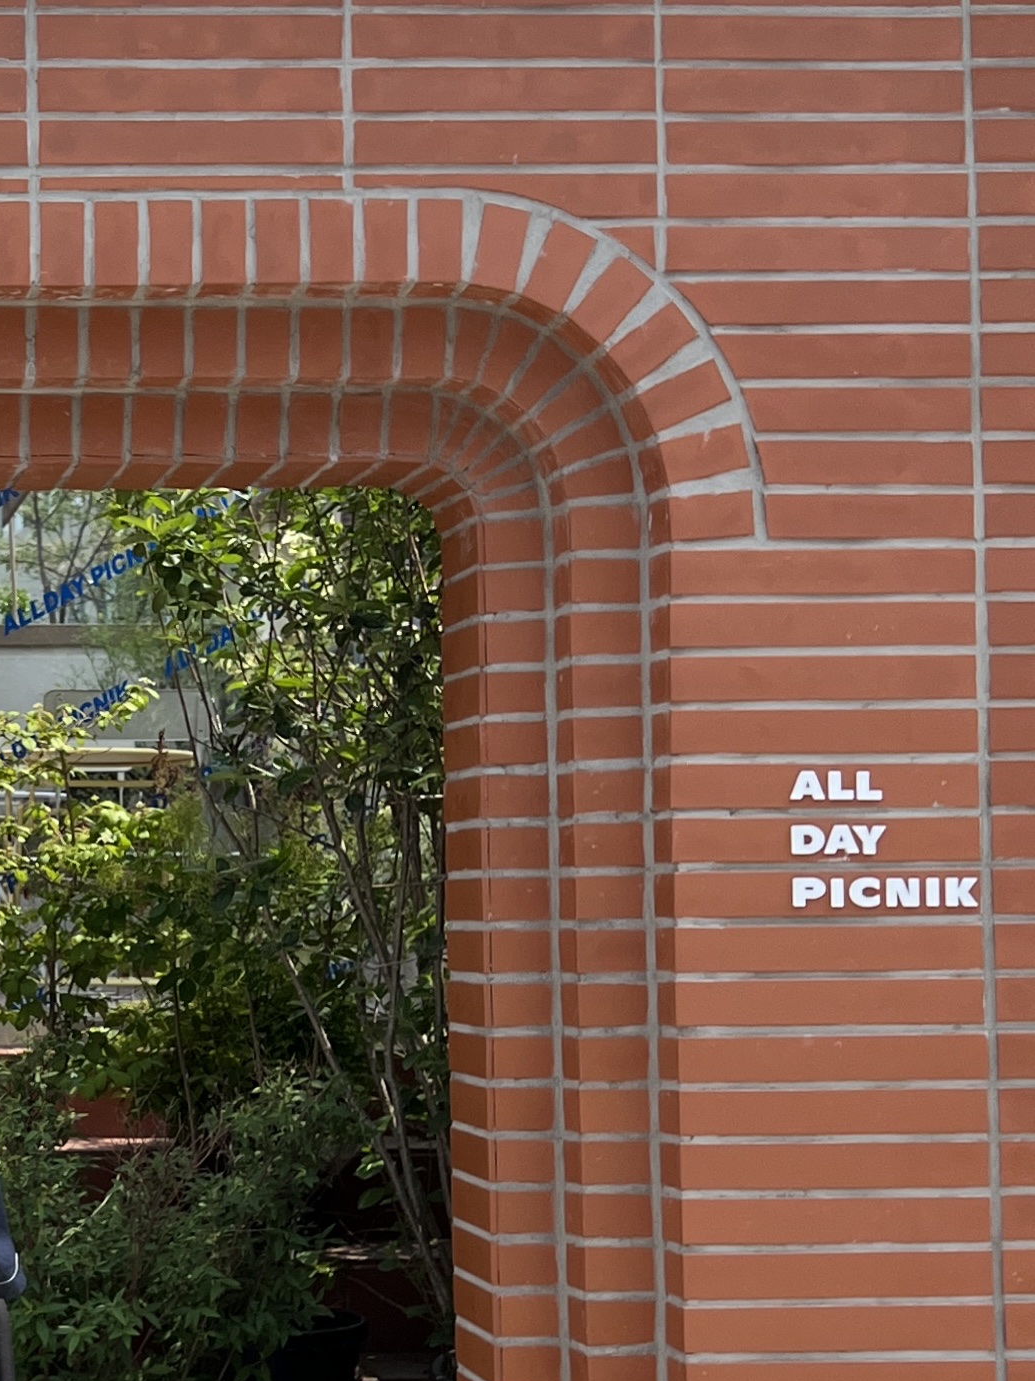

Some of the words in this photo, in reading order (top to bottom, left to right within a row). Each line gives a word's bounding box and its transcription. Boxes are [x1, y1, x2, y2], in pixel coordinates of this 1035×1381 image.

[4, 572, 84, 636] ALLDAY
[789, 770, 883, 800] ALL
[790, 824, 887, 855] DAY
[792, 876, 979, 908] PICNIK
